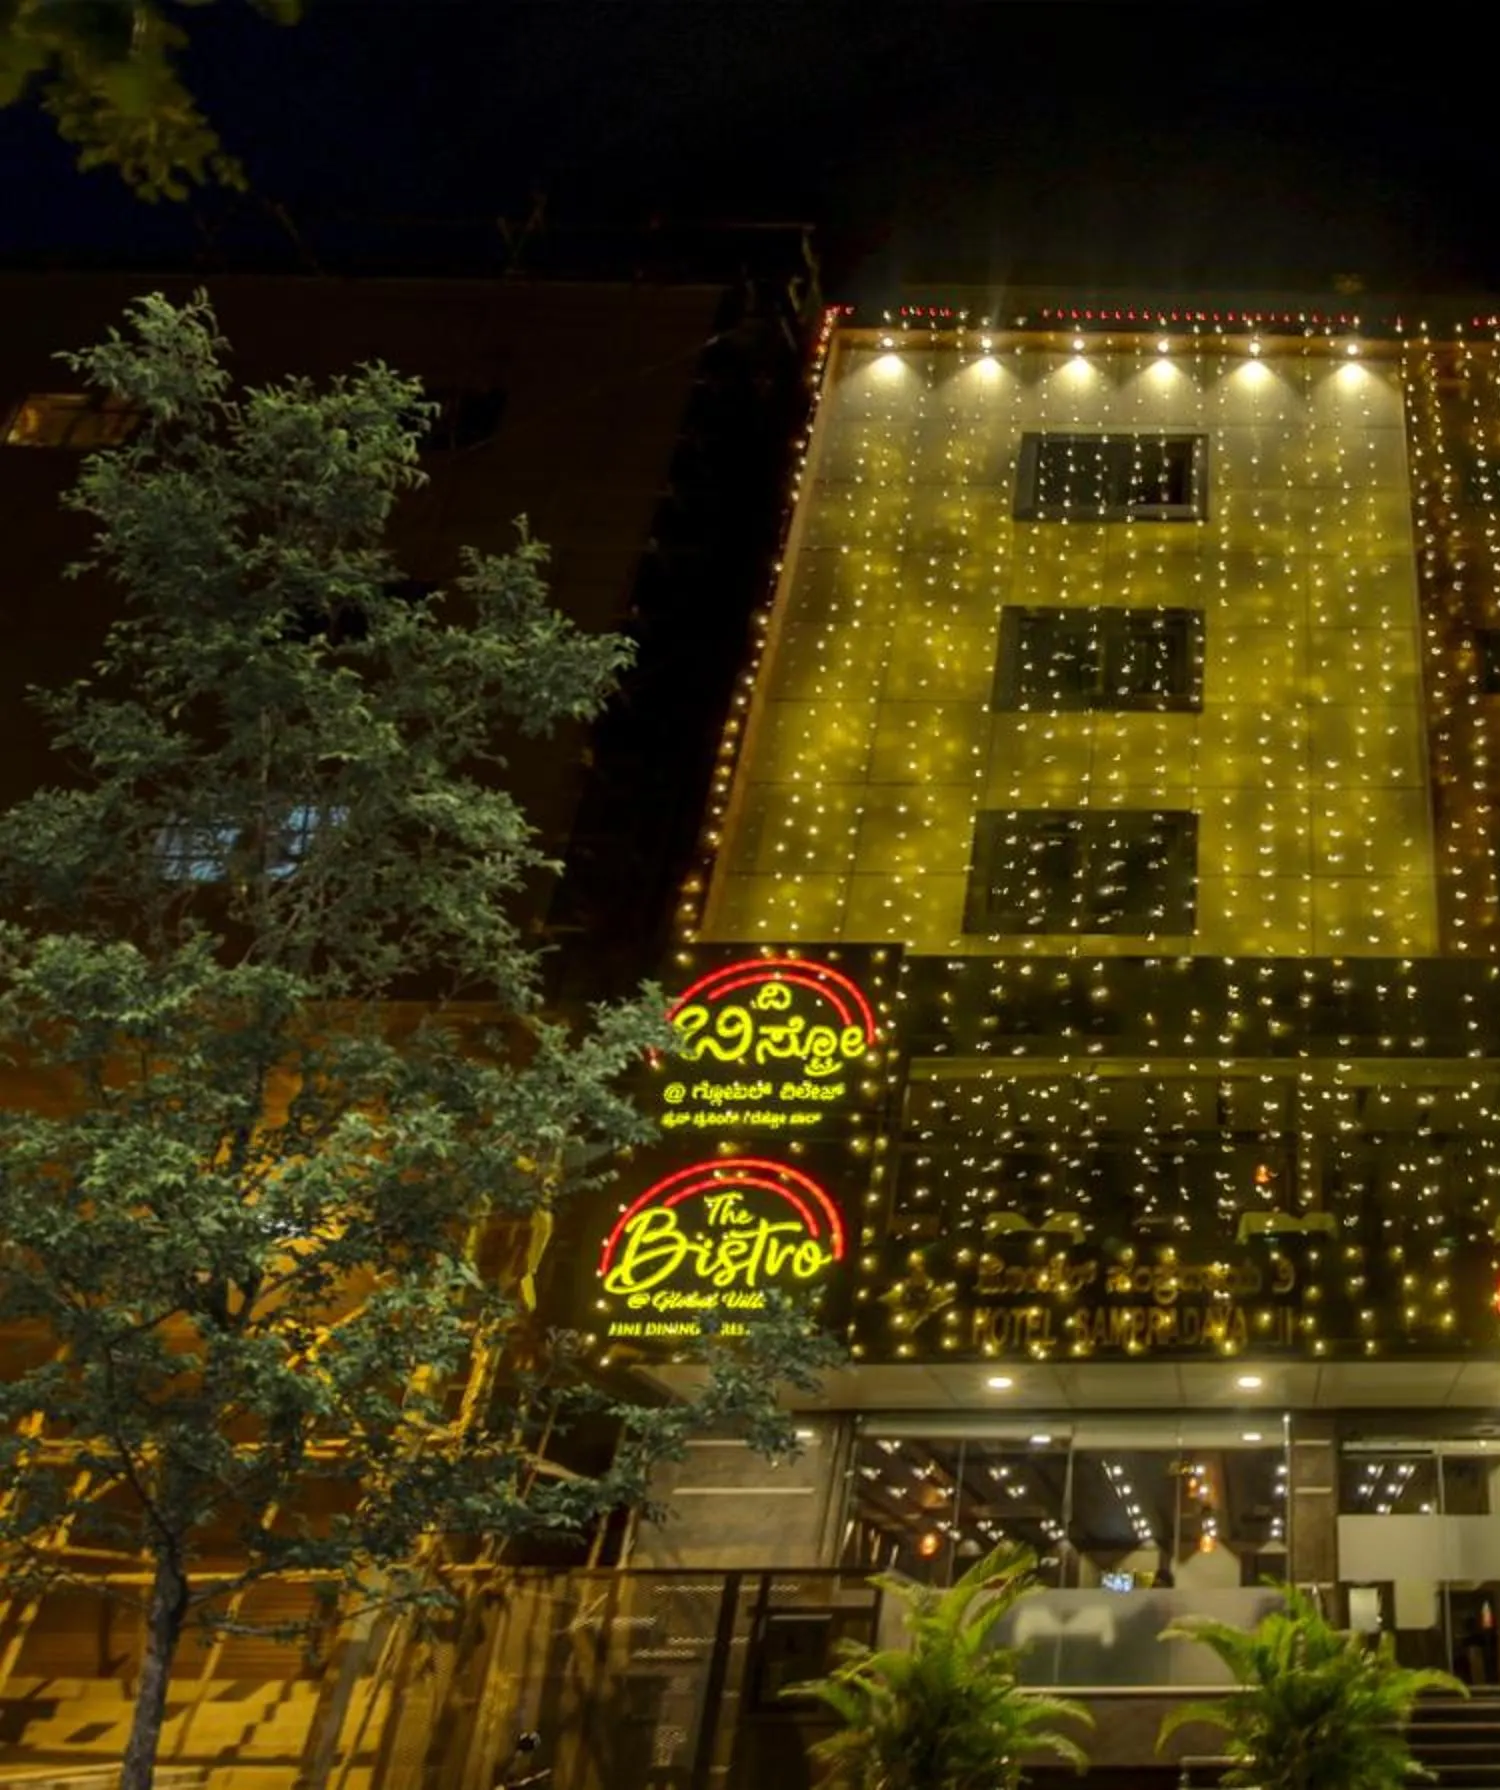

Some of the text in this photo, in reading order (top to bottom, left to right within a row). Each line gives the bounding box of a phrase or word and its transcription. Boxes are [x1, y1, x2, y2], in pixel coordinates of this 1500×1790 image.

[756, 981, 793, 1010] ದಿ
[663, 1082, 686, 1103] @
[704, 1189, 755, 1227] The
[604, 1206, 834, 1294] Bistro
[627, 1292, 650, 1308] @
[652, 1290, 719, 1312] Global
